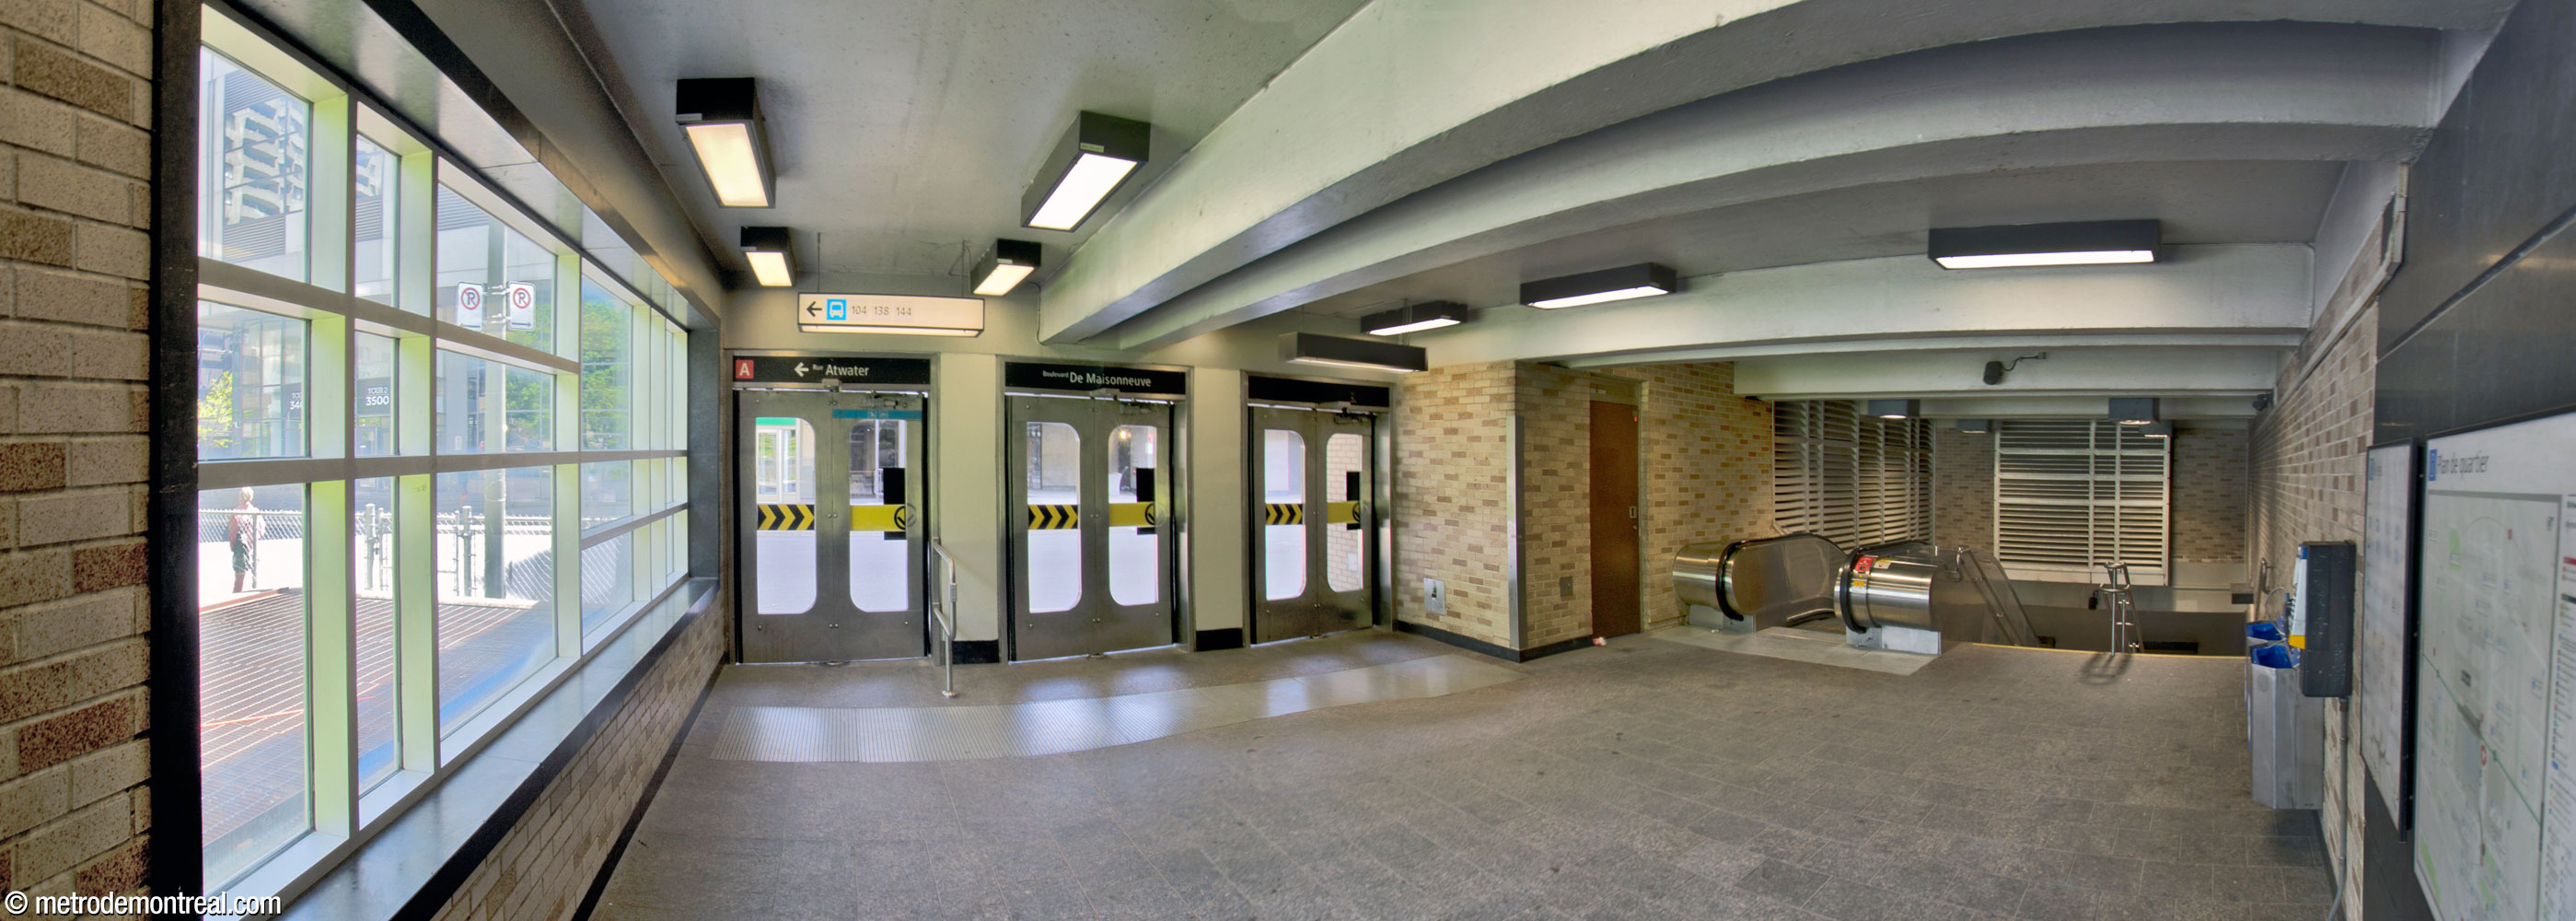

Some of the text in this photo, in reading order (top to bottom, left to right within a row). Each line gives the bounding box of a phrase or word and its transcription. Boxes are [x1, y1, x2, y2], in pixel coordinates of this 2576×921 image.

[852, 306, 911, 316] 104 138 144
[739, 363, 750, 377] A
[826, 364, 869, 377] Atwater
[1070, 371, 1084, 383] De
[1086, 373, 1152, 387] Maisonneuve
[366, 396, 389, 406] 3500
[2460, 450, 2489, 479] quartier
